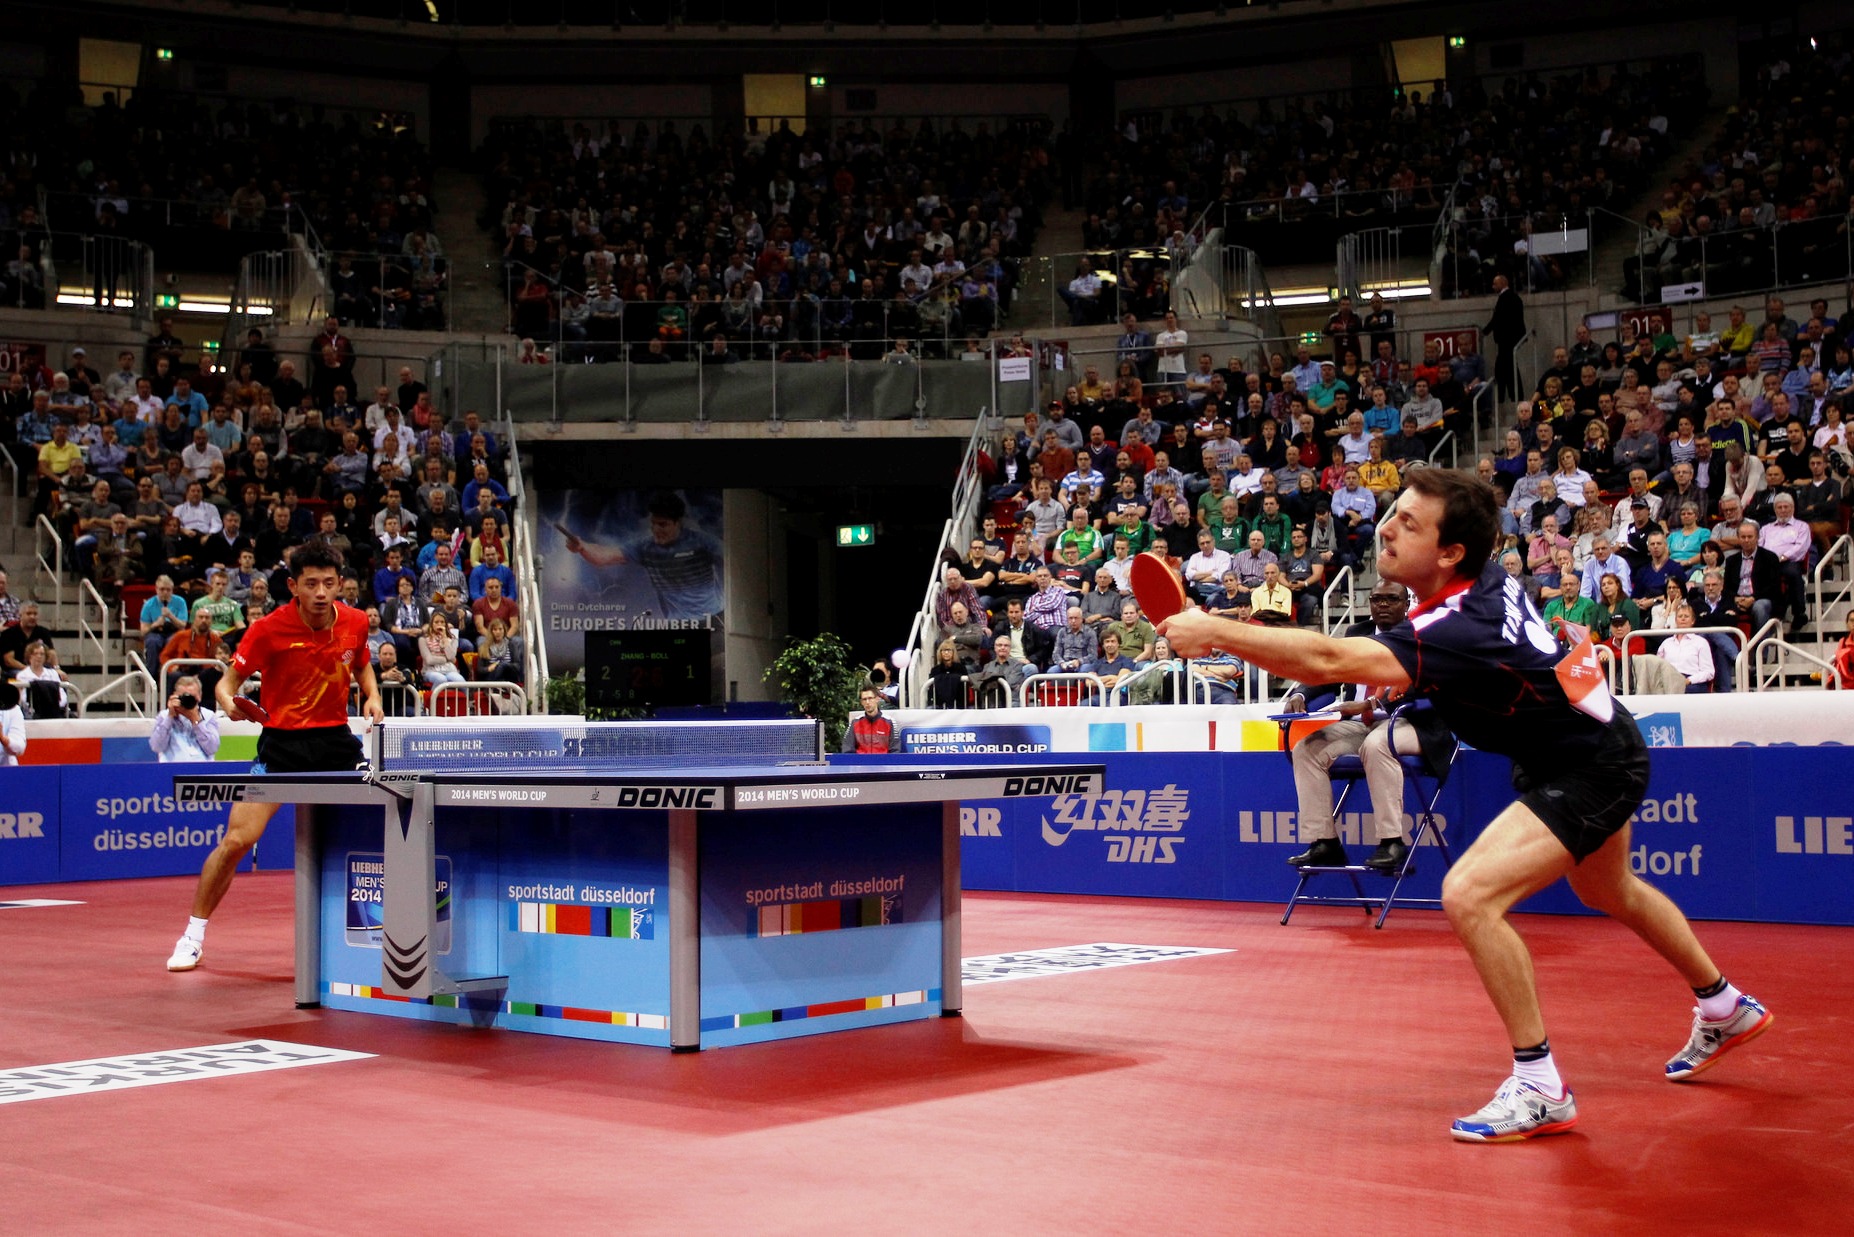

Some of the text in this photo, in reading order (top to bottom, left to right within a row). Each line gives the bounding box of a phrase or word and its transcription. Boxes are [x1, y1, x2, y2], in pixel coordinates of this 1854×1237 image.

[551, 602, 574, 611] Dima
[550, 614, 626, 631] EUROPE'S
[633, 615, 700, 631] NUMBER
[906, 732, 977, 744] LIEBHERR
[181, 785, 246, 801] DONIC
[1003, 776, 1091, 796] DONIC
[451, 790, 547, 801] 2014 MEN'S WORLD CUP
[617, 788, 716, 808] DONIC
[738, 787, 860, 802] 2014 MEN'S WORLD CUP
[1103, 835, 1185, 864] DHS
[351, 888, 382, 903] 2014
[508, 883, 655, 905] sportstadt düsseldorf
[746, 874, 904, 906] sportstadt düsseldorf
